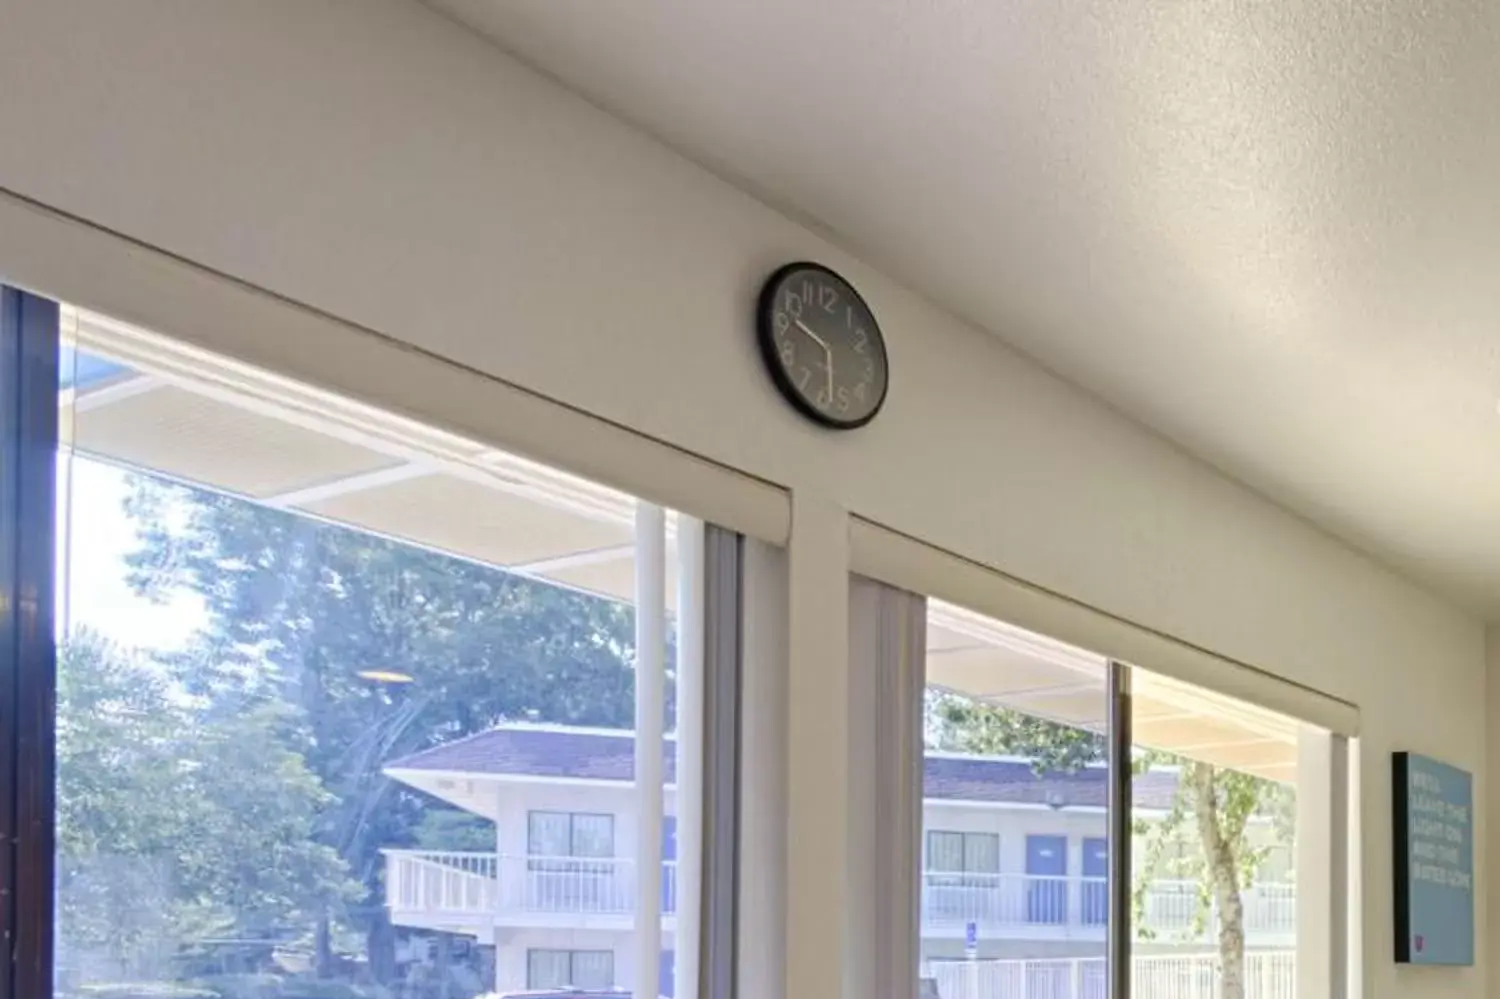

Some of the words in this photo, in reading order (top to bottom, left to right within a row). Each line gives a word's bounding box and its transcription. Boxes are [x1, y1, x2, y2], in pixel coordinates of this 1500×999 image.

[785, 289, 803, 316] 10
[818, 285, 839, 314] 12
[777, 312, 789, 336] 9
[845, 305, 853, 330] 1
[781, 340, 794, 367] 8
[853, 329, 868, 354] 2
[799, 366, 812, 392] 7
[837, 386, 850, 414] 5
